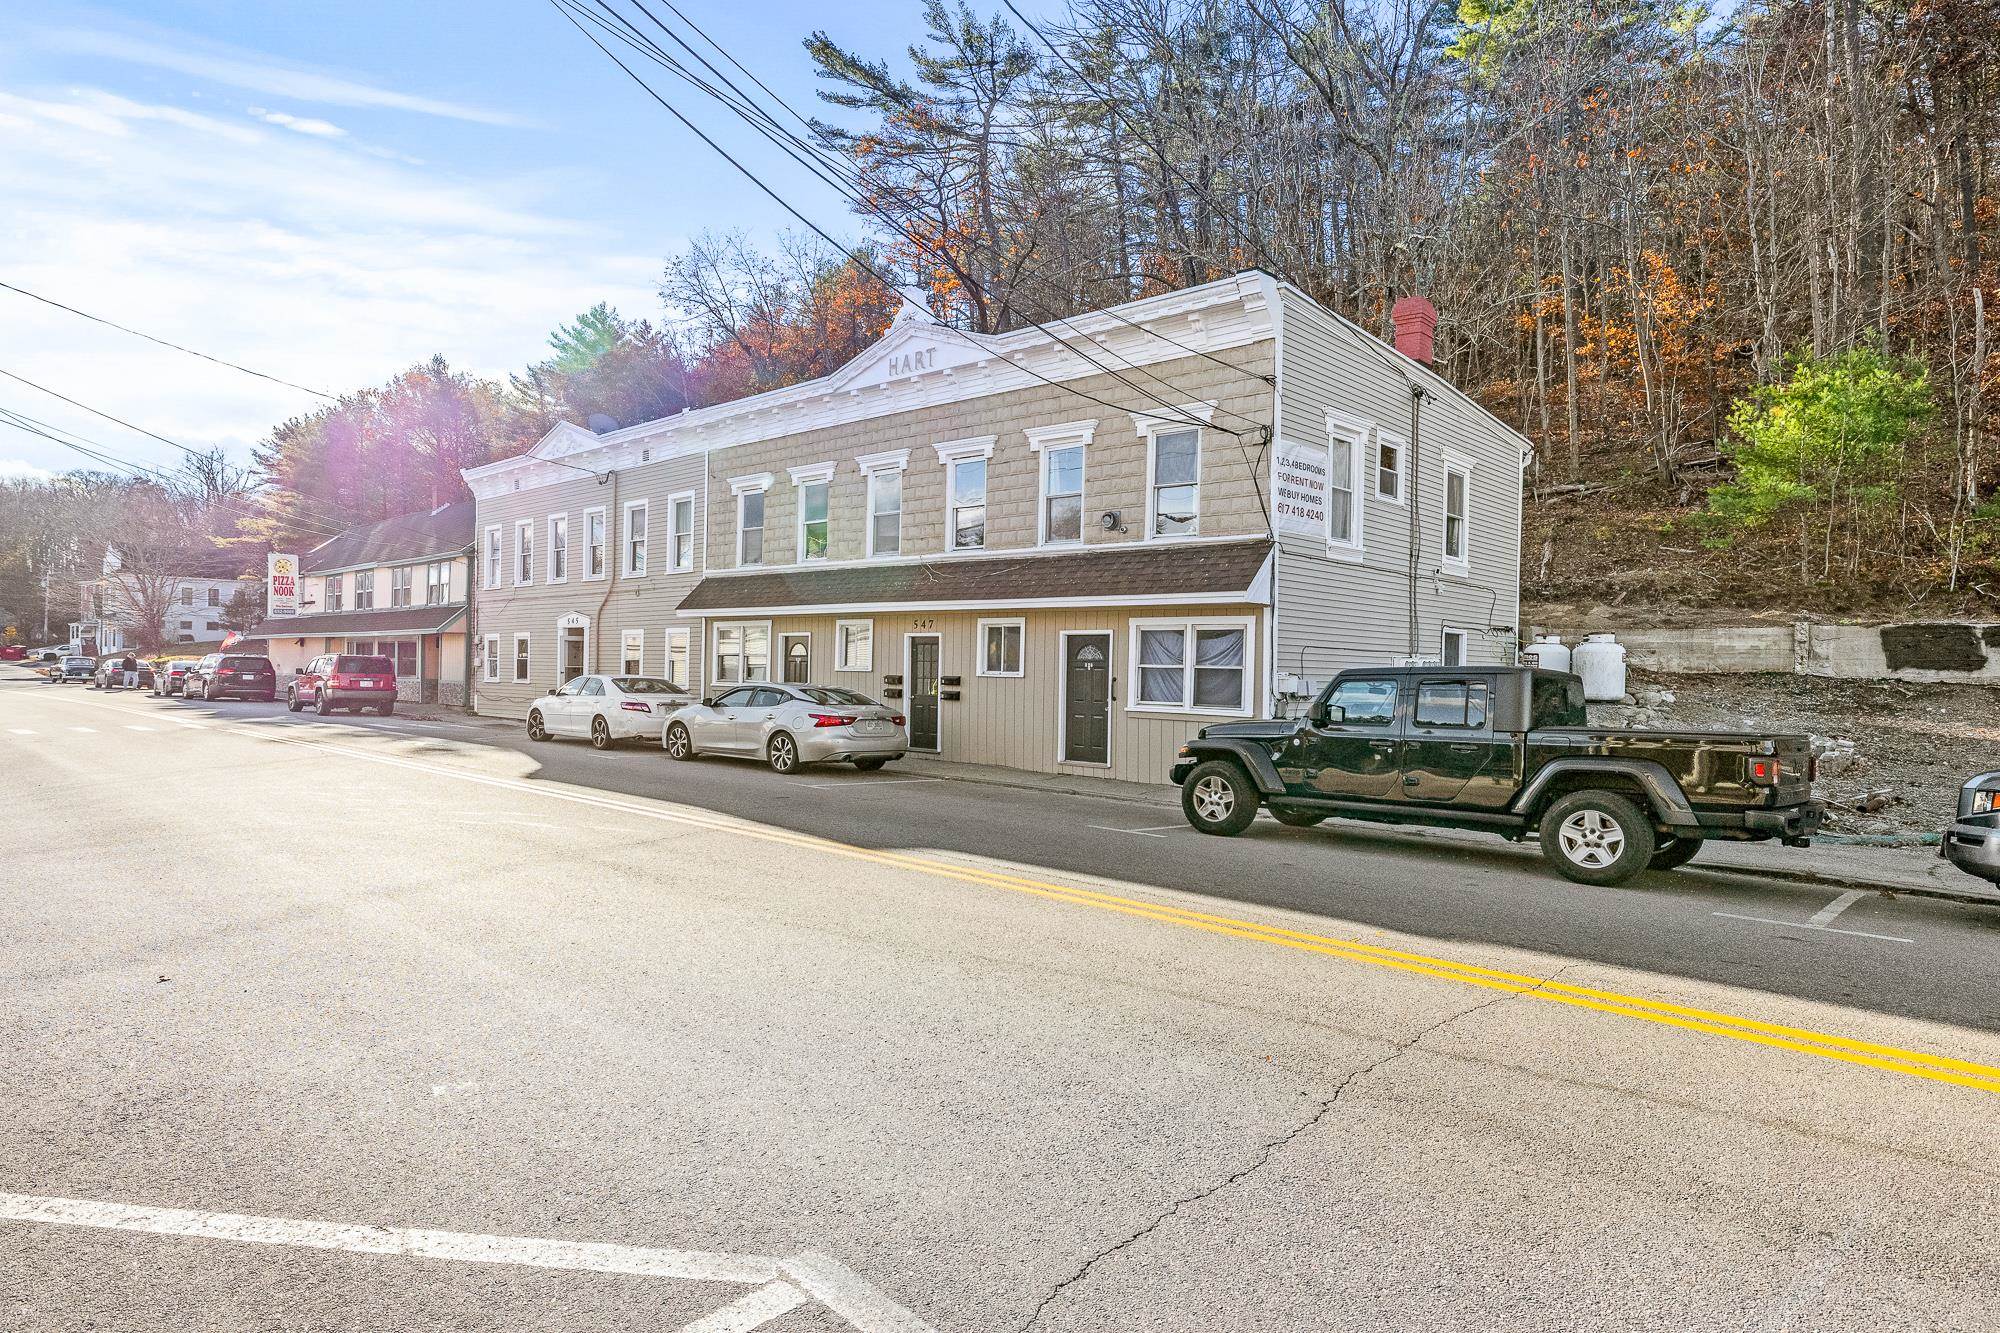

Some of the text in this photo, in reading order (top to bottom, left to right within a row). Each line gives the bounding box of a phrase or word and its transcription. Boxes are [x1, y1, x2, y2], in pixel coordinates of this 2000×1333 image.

[889, 347, 936, 376] HART
[1277, 472, 1325, 491] FOR RENT NOW
[1286, 489, 1300, 500] BUY
[1300, 492, 1323, 506] HOMES
[1277, 502, 1324, 522] 617 418 4240
[272, 575, 295, 586] PIZZA
[273, 586, 295, 596] NOOK
[913, 619, 934, 629] 547
